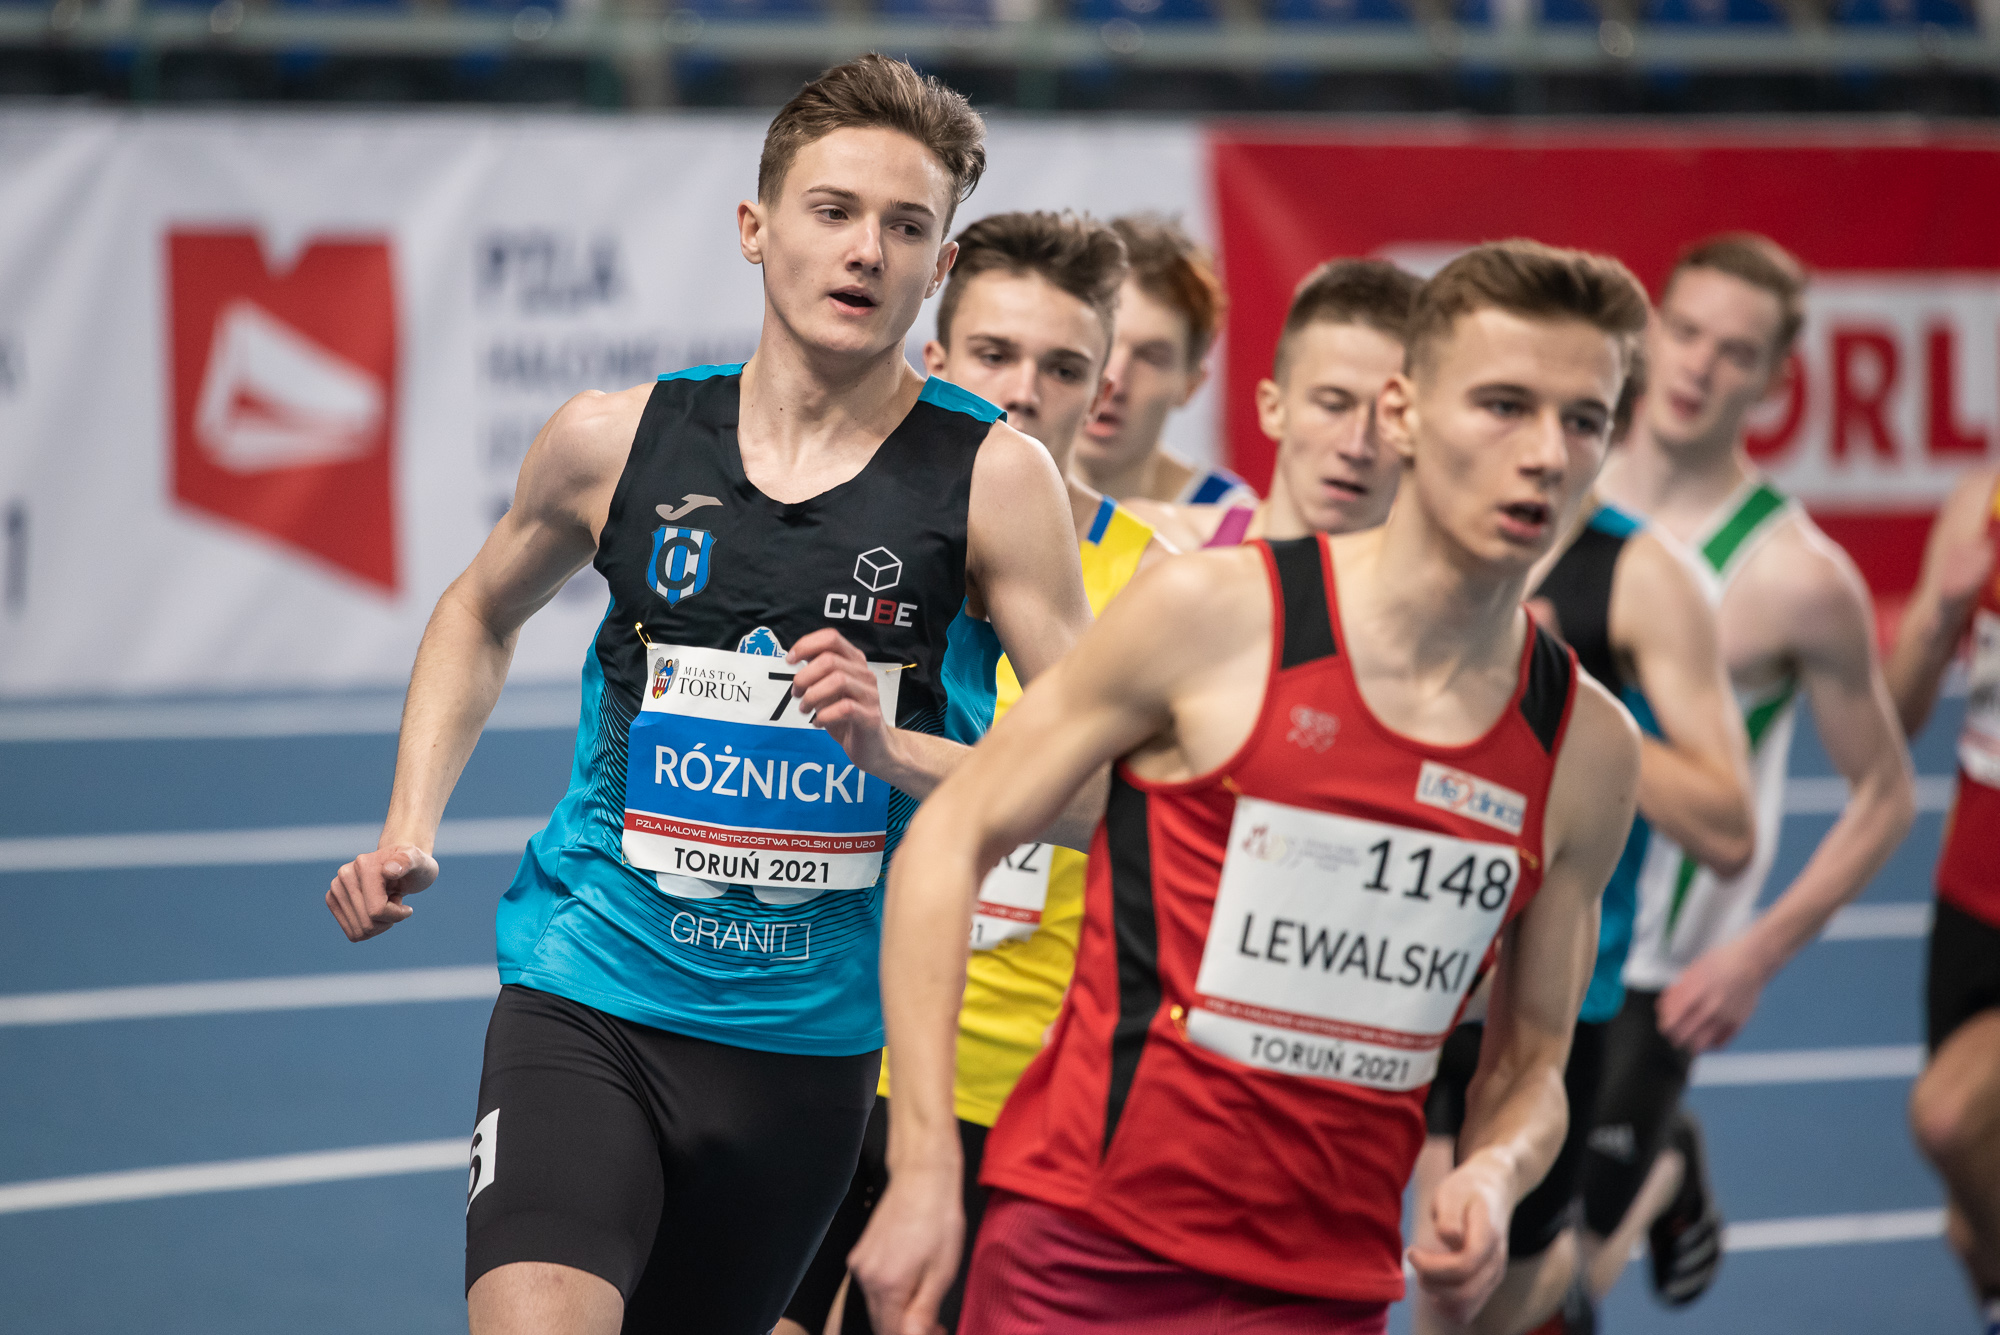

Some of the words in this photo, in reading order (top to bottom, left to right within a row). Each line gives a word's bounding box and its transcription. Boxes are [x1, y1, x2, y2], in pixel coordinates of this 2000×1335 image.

[823, 593, 918, 628] CUBE
[678, 677, 752, 703] TORUŃ
[683, 666, 736, 682] MIASTO
[654, 742, 867, 804] RÓŻNICKI
[635, 818, 662, 831] PZLA
[664, 823, 707, 839] HALOWE
[708, 832, 789, 847] MISTRZOSTWA
[791, 839, 831, 849] POLSKI
[833, 840, 853, 849] U18
[855, 840, 876, 849] U20
[674, 847, 760, 880] TORUŃ
[768, 859, 830, 884] 2021
[1363, 838, 1513, 912] 1148
[670, 911, 798, 954] GRANIT
[1237, 912, 1471, 995] LEWALSKI
[1251, 1034, 1346, 1073] TORUŃ
[1352, 1052, 1411, 1083] 2021
